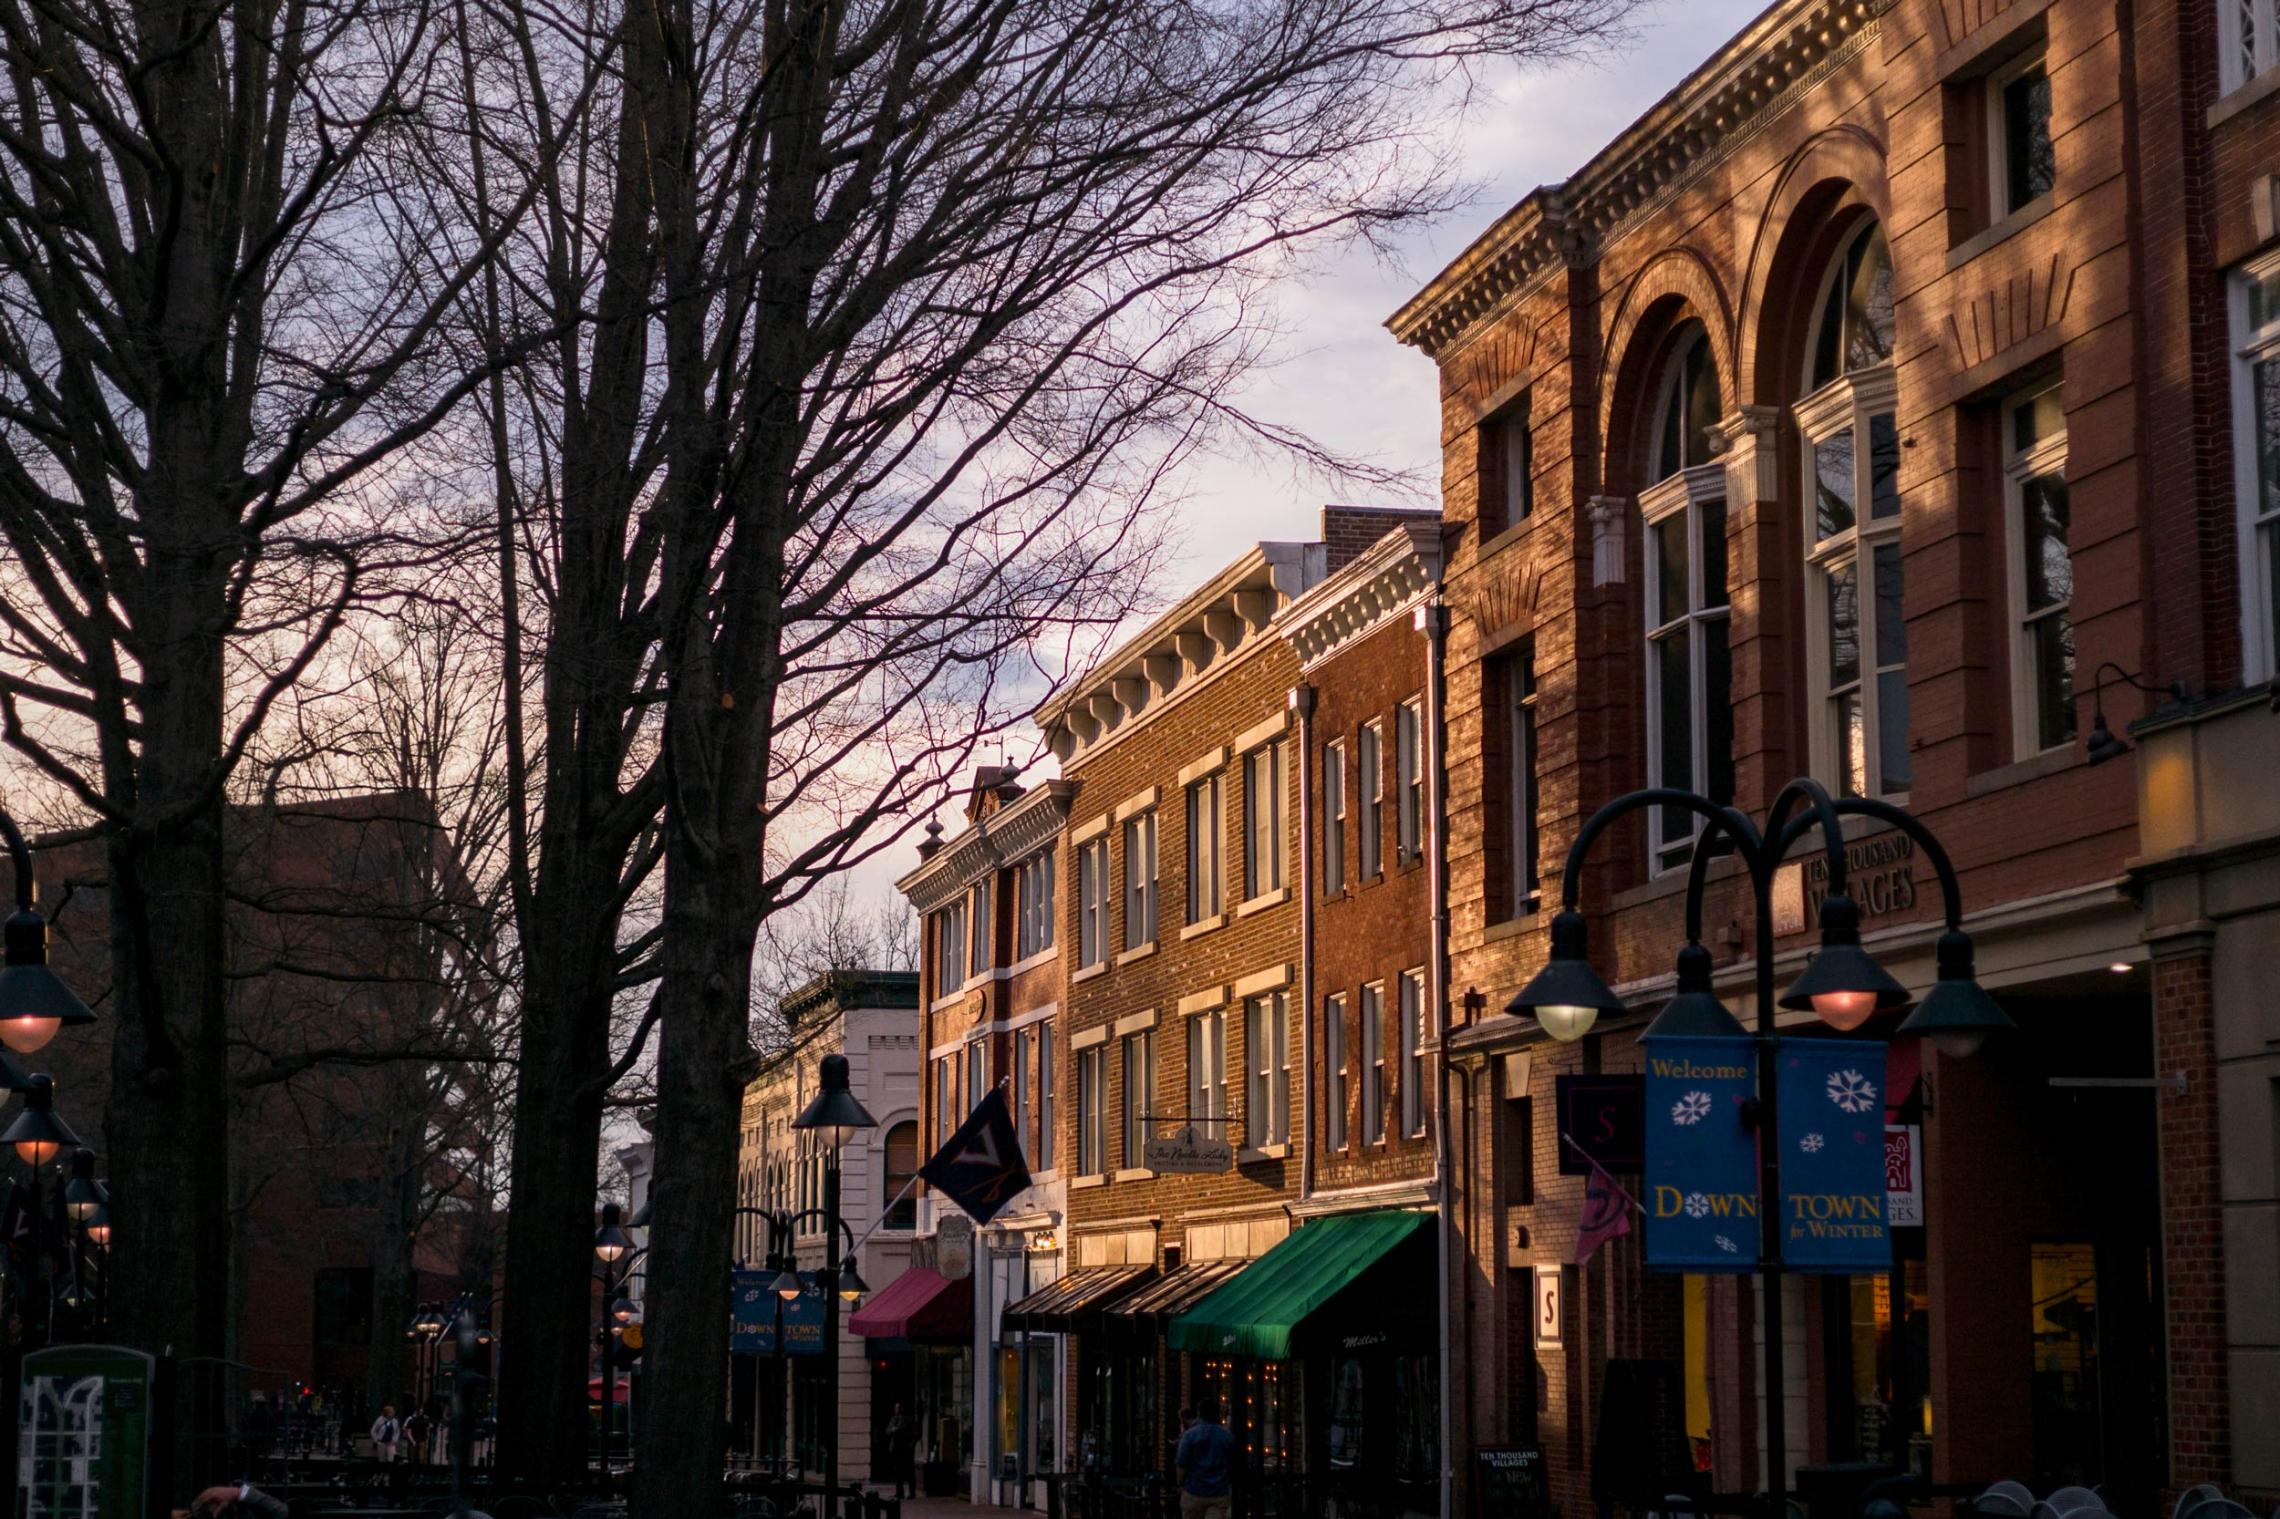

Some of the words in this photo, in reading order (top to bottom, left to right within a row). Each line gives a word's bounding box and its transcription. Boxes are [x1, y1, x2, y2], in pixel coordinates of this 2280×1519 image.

[1843, 834, 1912, 873] HOUSAND
[1651, 1058, 1748, 1079] Welcome
[1594, 1105, 1616, 1143] S
[1788, 1195, 1882, 1220] TOWN
[1790, 1224, 1804, 1239] for
[1545, 1290, 1554, 1324] S
[1480, 1452, 1495, 1460] TEN
[1497, 1450, 1539, 1460] THOUSAND
[1492, 1459, 1528, 1468] VILLAGES
